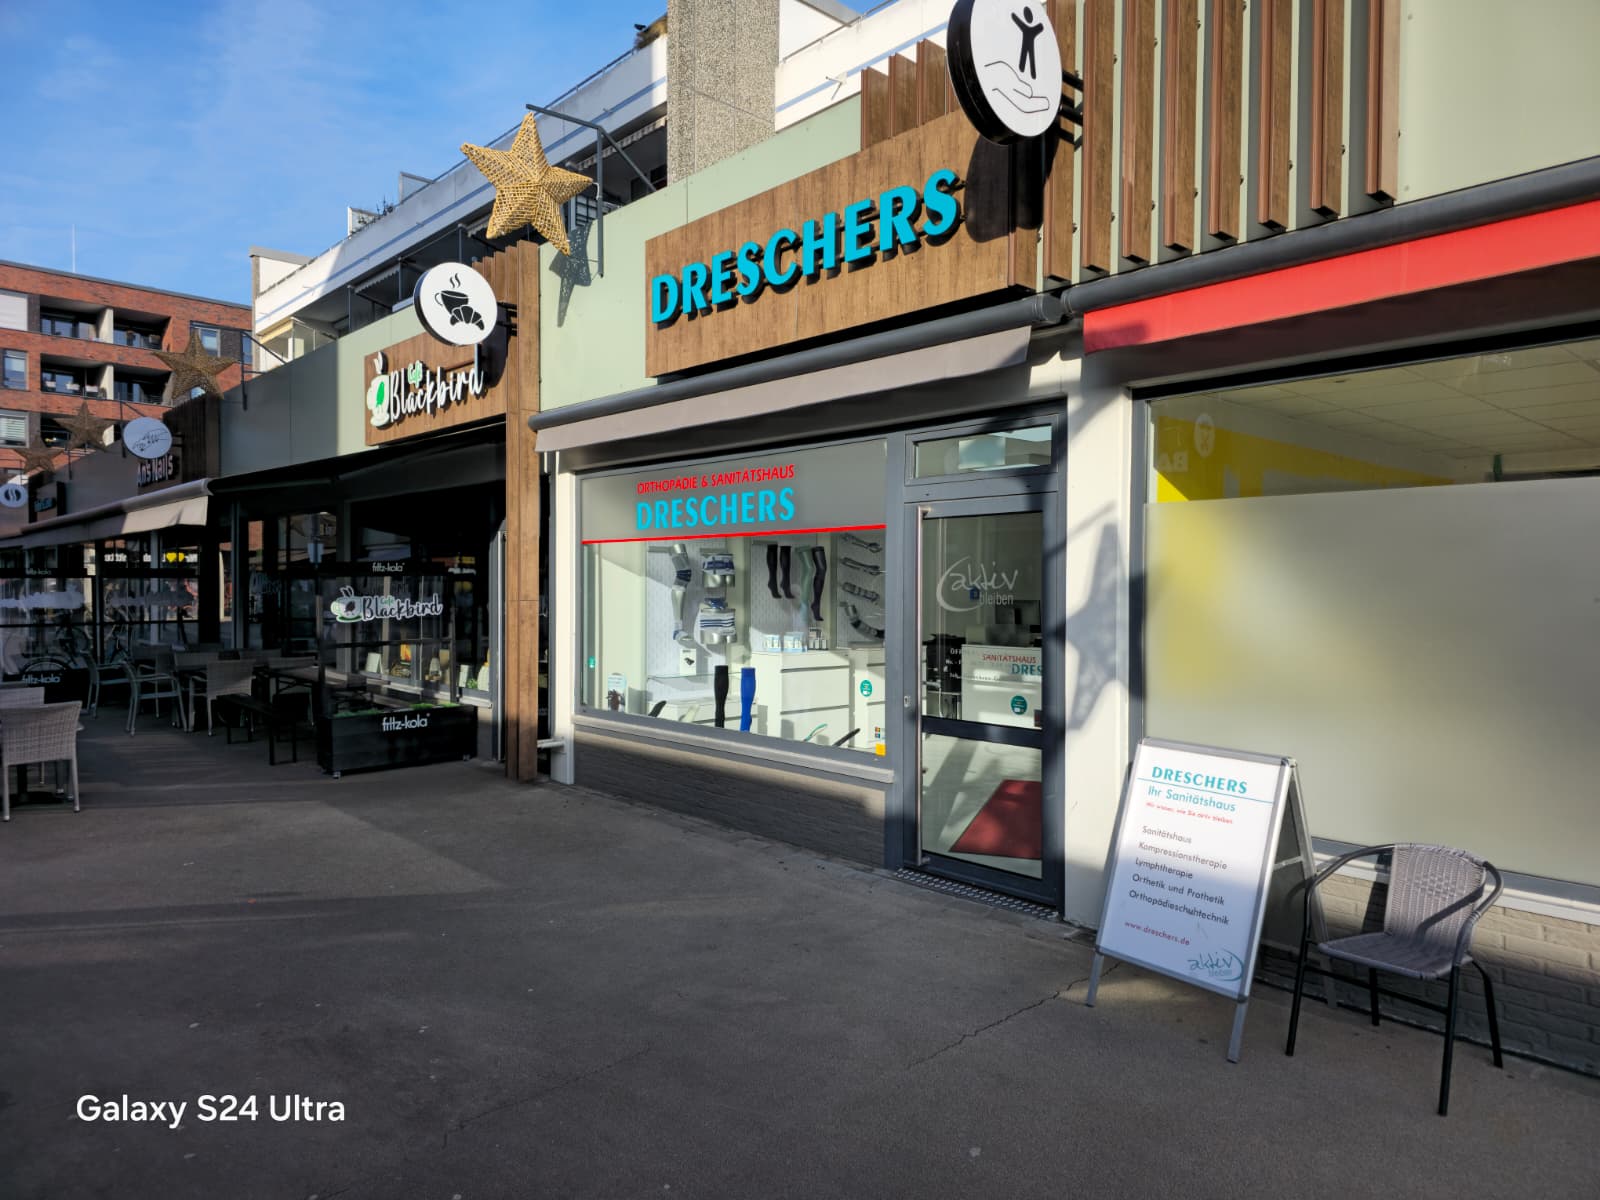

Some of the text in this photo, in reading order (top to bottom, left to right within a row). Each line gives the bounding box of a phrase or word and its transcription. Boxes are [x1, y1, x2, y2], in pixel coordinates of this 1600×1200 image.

[651, 168, 958, 324] DRESCHERS
[390, 366, 484, 422] Blackbird
[637, 464, 795, 494] ORTHOPÄDIE & SANITÄTSHAUS
[636, 487, 795, 531] DRESCHERS
[949, 561, 1018, 591] aktiv
[362, 593, 442, 620] Blackbird
[980, 591, 1014, 606] bleiben
[382, 714, 428, 731] fritz-kola
[1151, 766, 1248, 794] DRESCHERS
[1148, 785, 1236, 812] Ihr Sanitätshaus
[1142, 826, 1192, 844] Sanitätshaus
[1135, 857, 1193, 879] Lymphtherapie
[1138, 842, 1228, 870] Kompressionstherapie
[1132, 873, 1225, 905] Orthetik und Prothetik
[1129, 890, 1230, 925] Orthopädieschuhtechnik
[1124, 921, 1190, 946] www.dreschers.de
